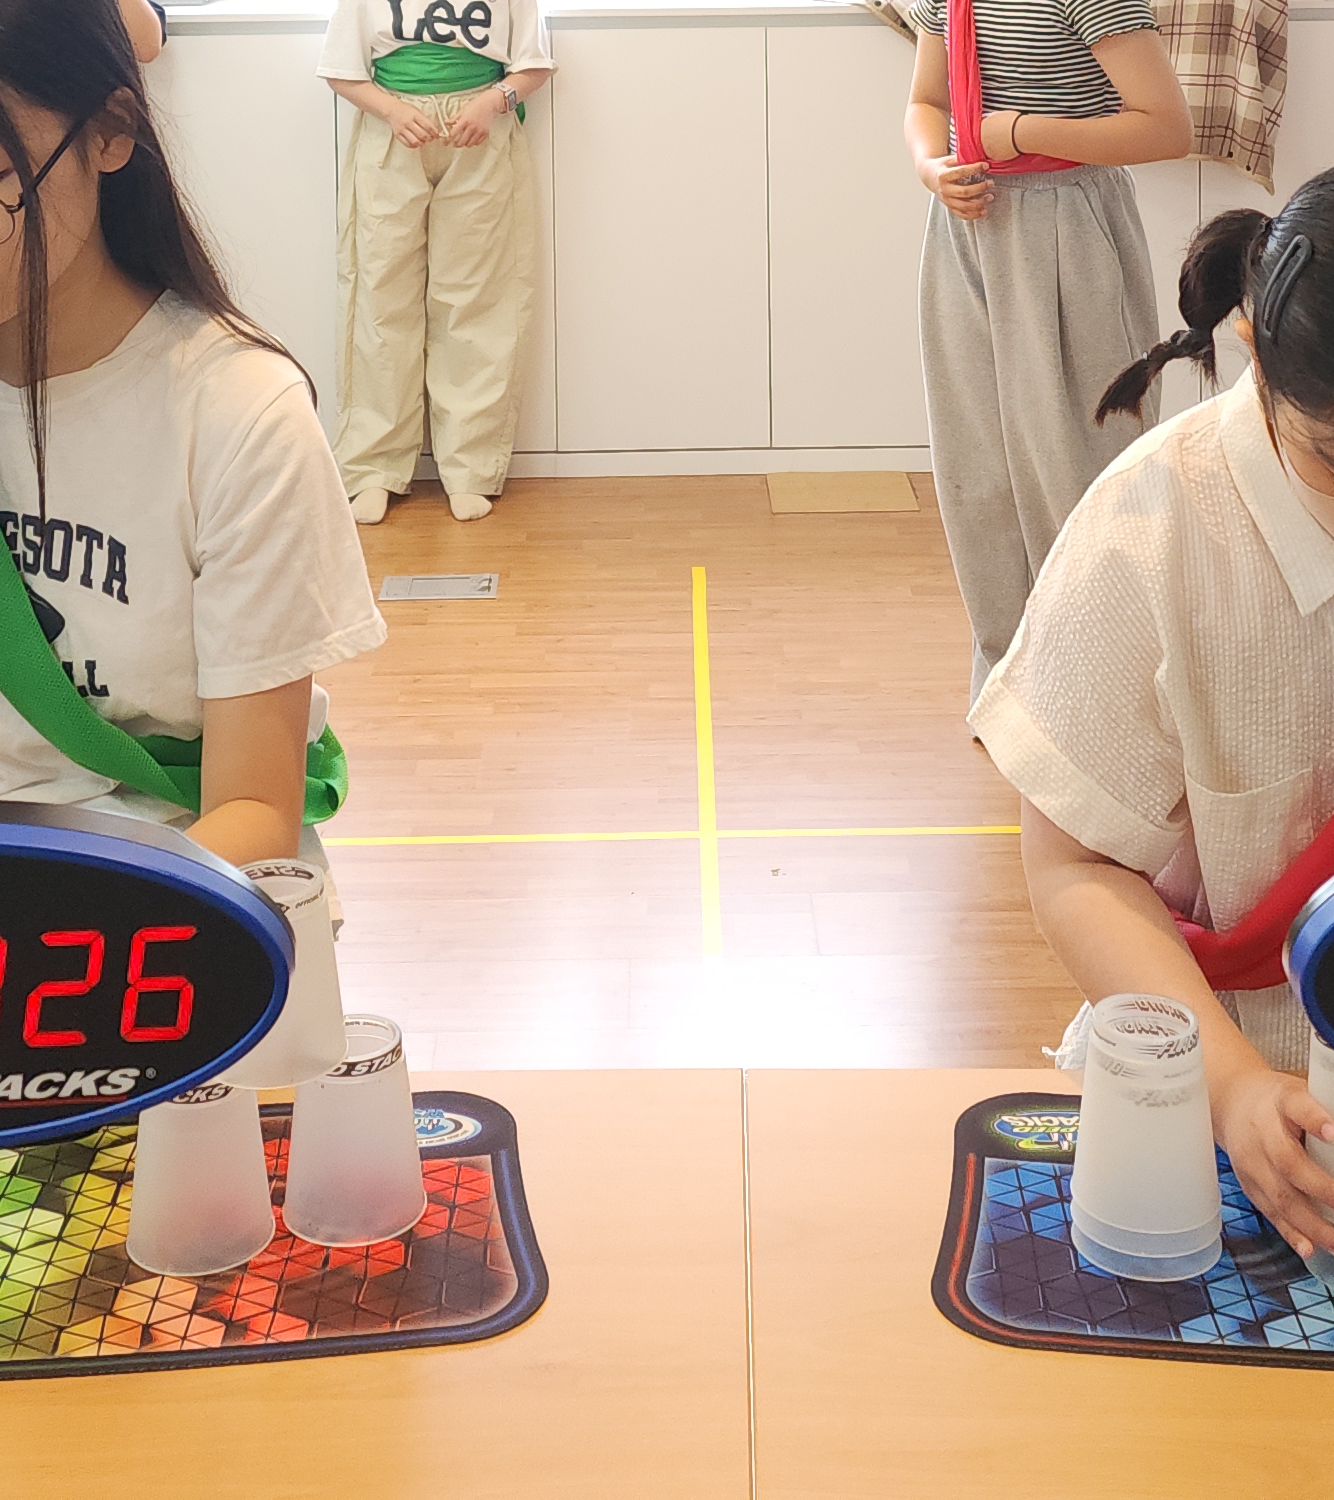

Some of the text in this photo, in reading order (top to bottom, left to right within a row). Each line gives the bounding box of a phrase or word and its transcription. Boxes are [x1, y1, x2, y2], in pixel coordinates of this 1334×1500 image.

[351, 1046, 402, 1075] STAC
[172, 1085, 226, 1103] CKS
[1001, 1116, 1079, 1127] ACKS
[1013, 1126, 1078, 1134] PEED
